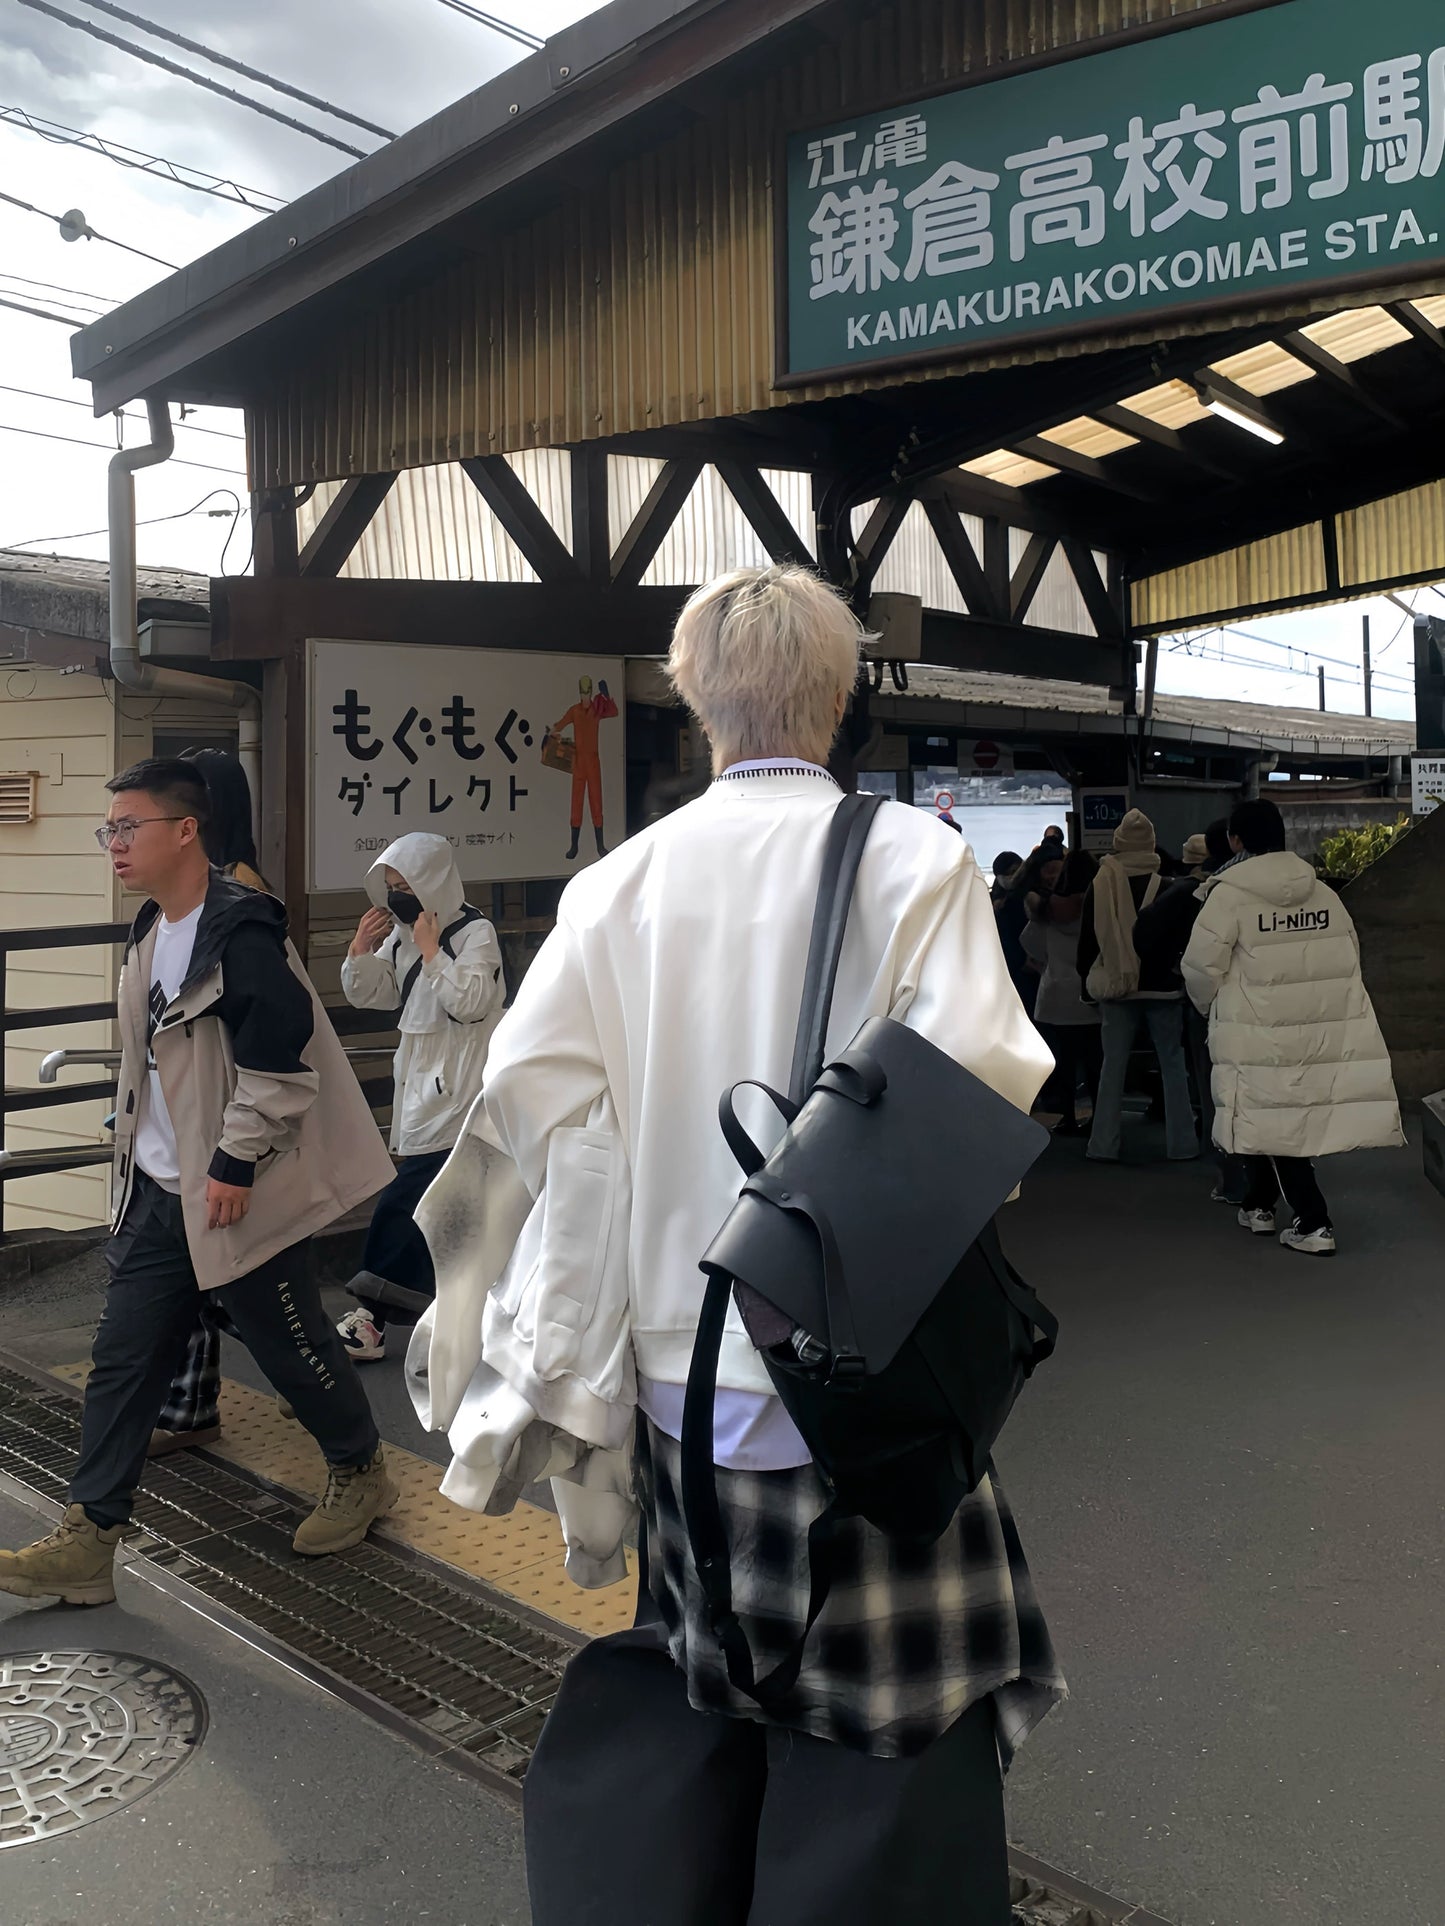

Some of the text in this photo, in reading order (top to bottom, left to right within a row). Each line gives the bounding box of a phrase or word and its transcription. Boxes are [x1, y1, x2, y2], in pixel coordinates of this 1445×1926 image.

[807, 113, 927, 190] 江ノ電
[846, 208, 1439, 350] KAMAKURAKOKOMAE STA.
[332, 688, 534, 765] もぐもぐ
[337, 772, 529, 817] ダイレクト
[1258, 908, 1329, 932] Li-Ning
